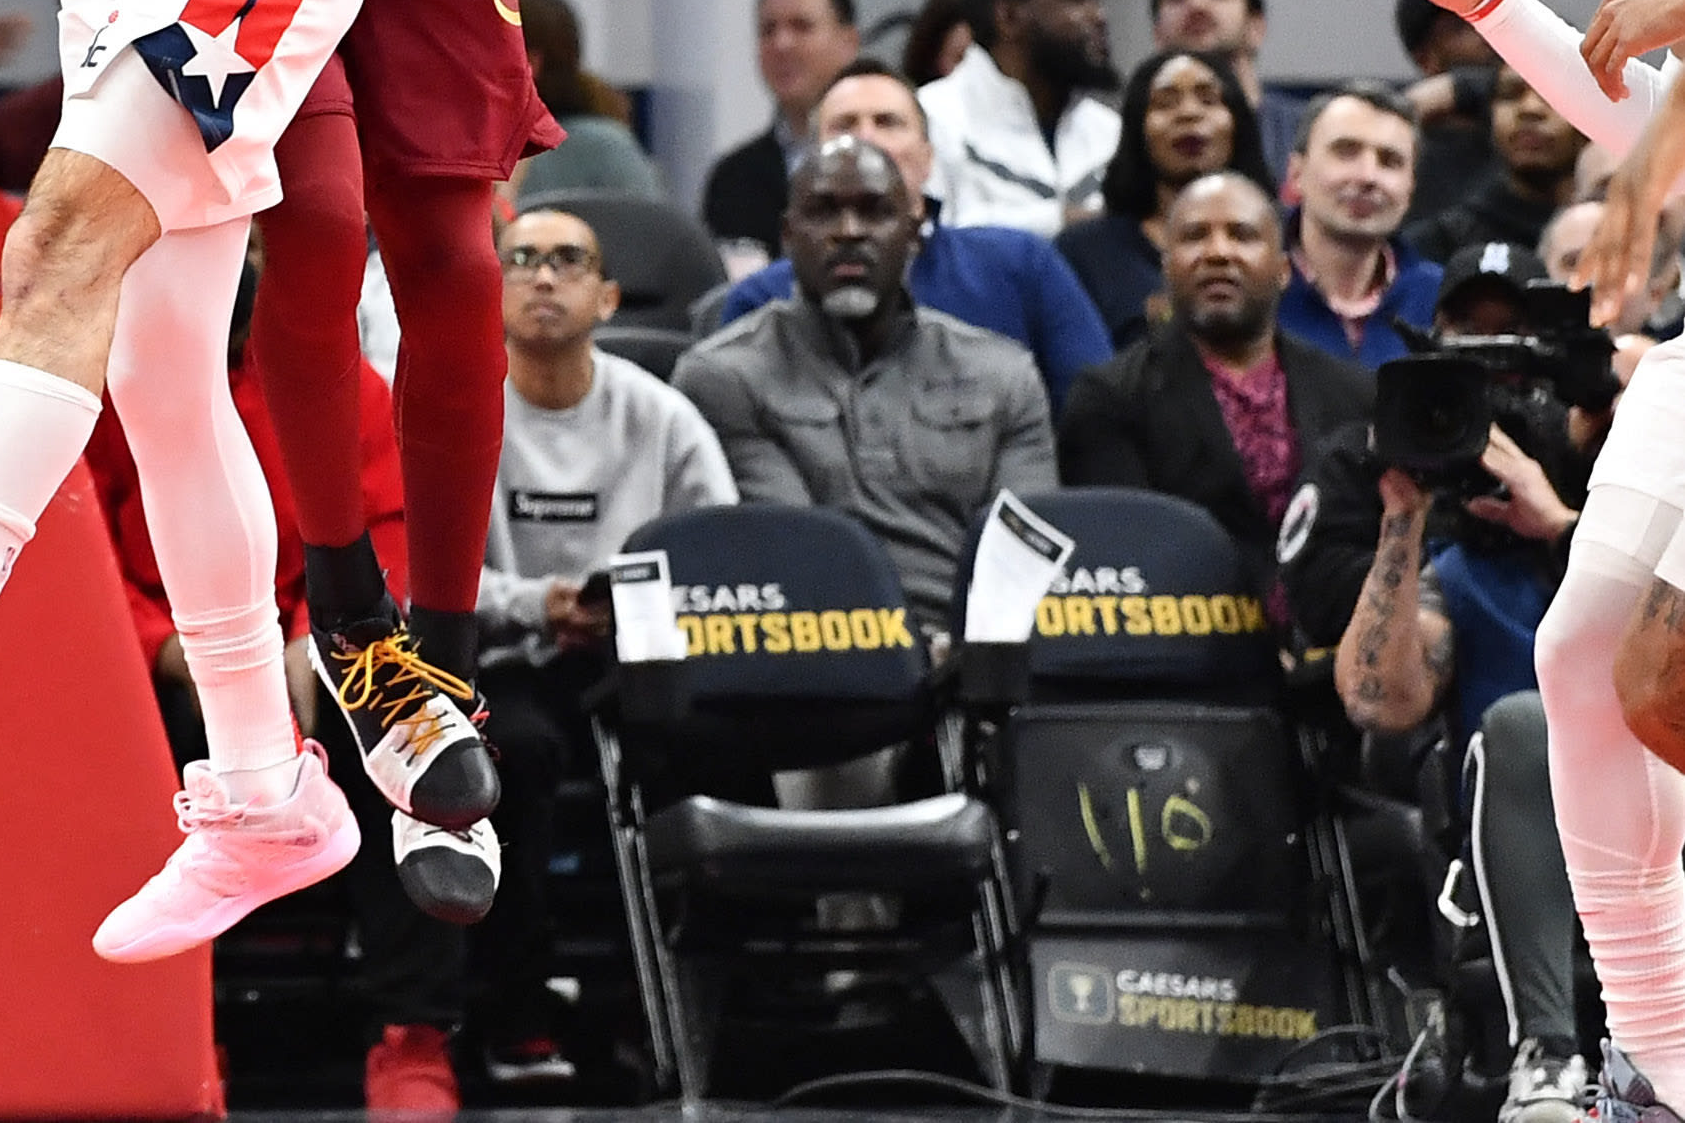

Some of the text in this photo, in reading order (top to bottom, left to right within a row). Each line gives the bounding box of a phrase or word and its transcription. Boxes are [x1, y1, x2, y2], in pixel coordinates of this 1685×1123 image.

[670, 583, 787, 612] ESARS
[1036, 595, 1265, 637] ORTSBOOK
[676, 608, 914, 655] ORTSBOOK
[1116, 969, 1237, 1001] CAESARS
[1117, 993, 1318, 1040] SPORTSBOOK
